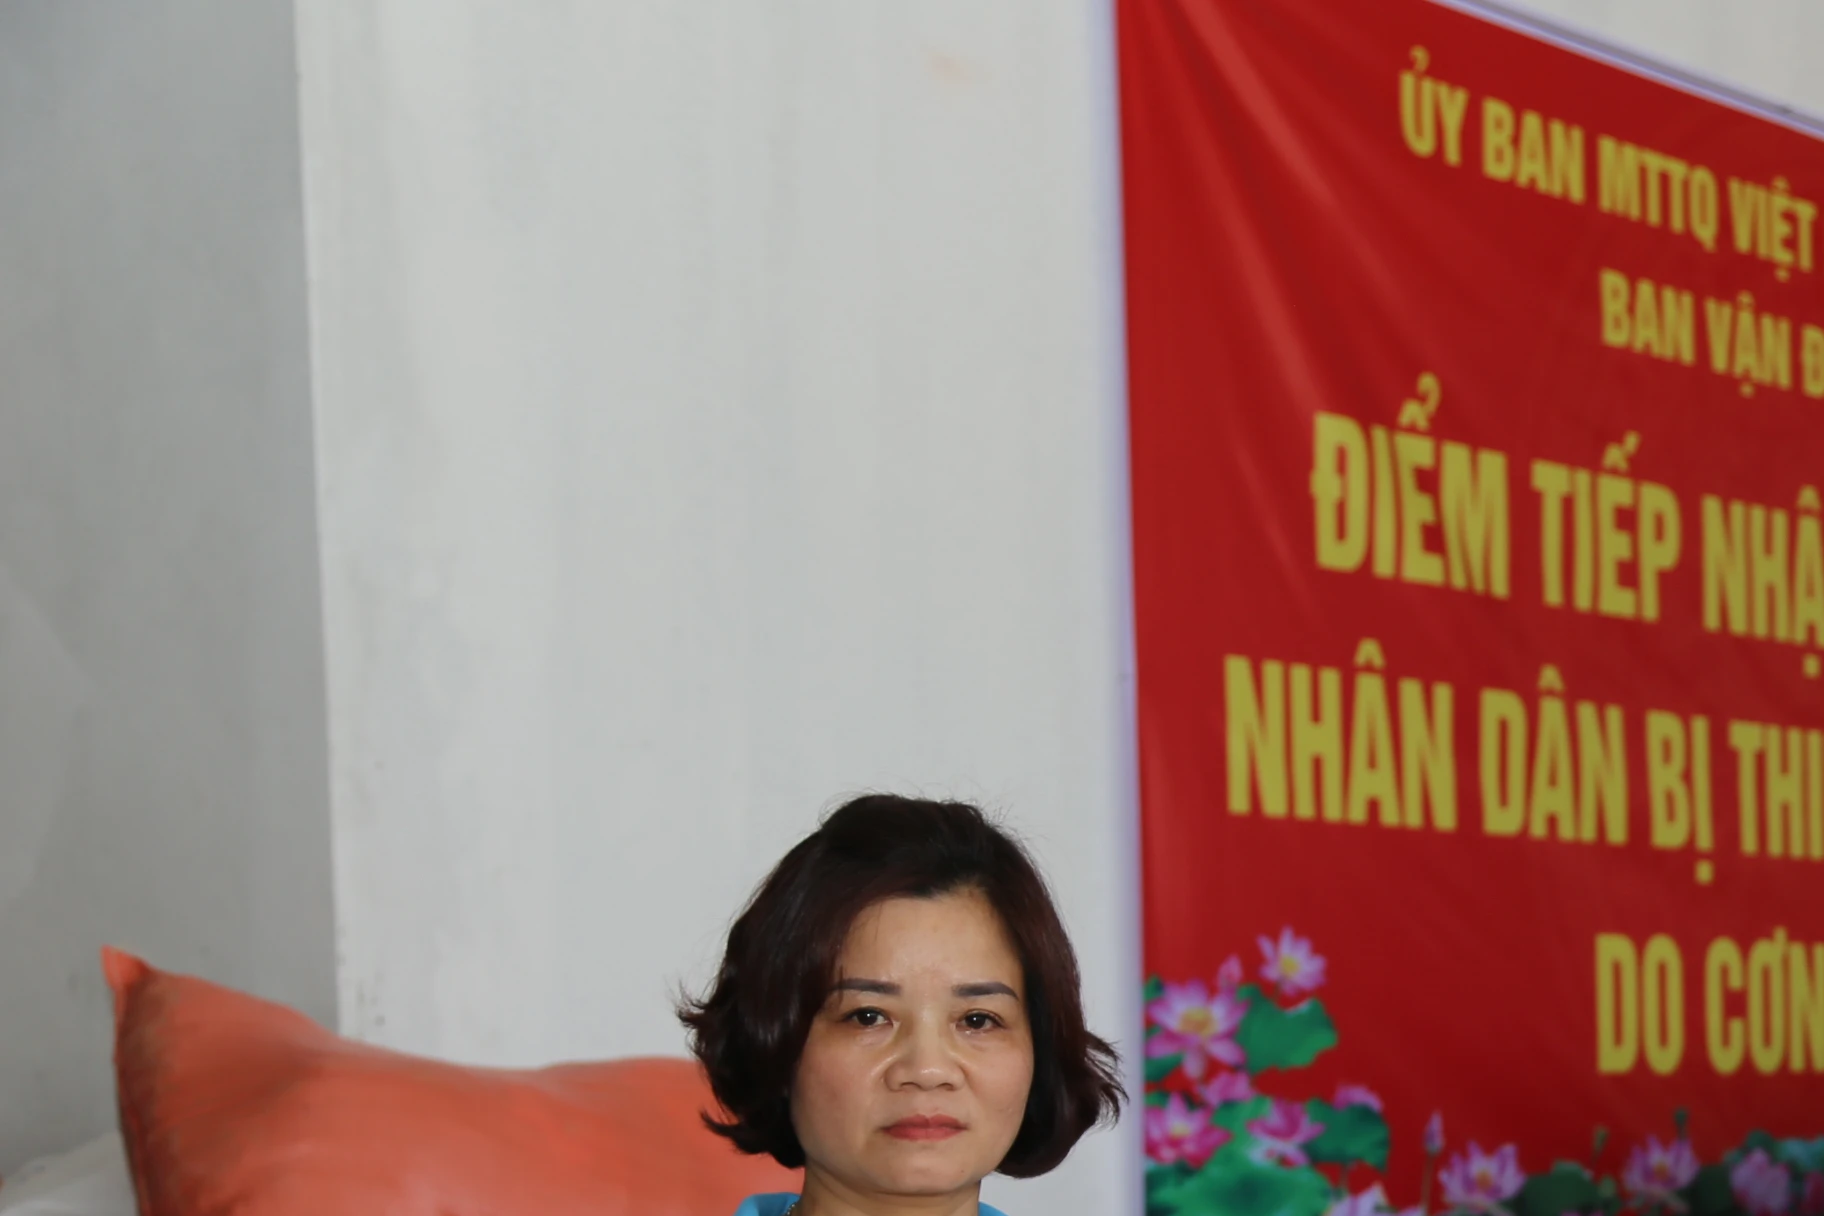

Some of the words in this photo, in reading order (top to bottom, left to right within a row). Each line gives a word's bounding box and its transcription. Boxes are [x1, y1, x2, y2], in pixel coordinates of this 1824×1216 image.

[1399, 46, 1469, 166] ỦY
[1482, 97, 1586, 204] BAN
[1597, 135, 1719, 250] MTTQ
[1728, 178, 1817, 280] VIỆT
[1599, 268, 1696, 365] BAN
[1704, 292, 1792, 395] VẬN
[1309, 372, 1510, 599] ĐIỂM
[1530, 431, 1682, 622] TIẾP
[1223, 637, 1458, 832] NHÂN
[1479, 664, 1629, 845] DÂN
[1645, 709, 1714, 884] BỊ
[1594, 932, 1685, 1075] DO
